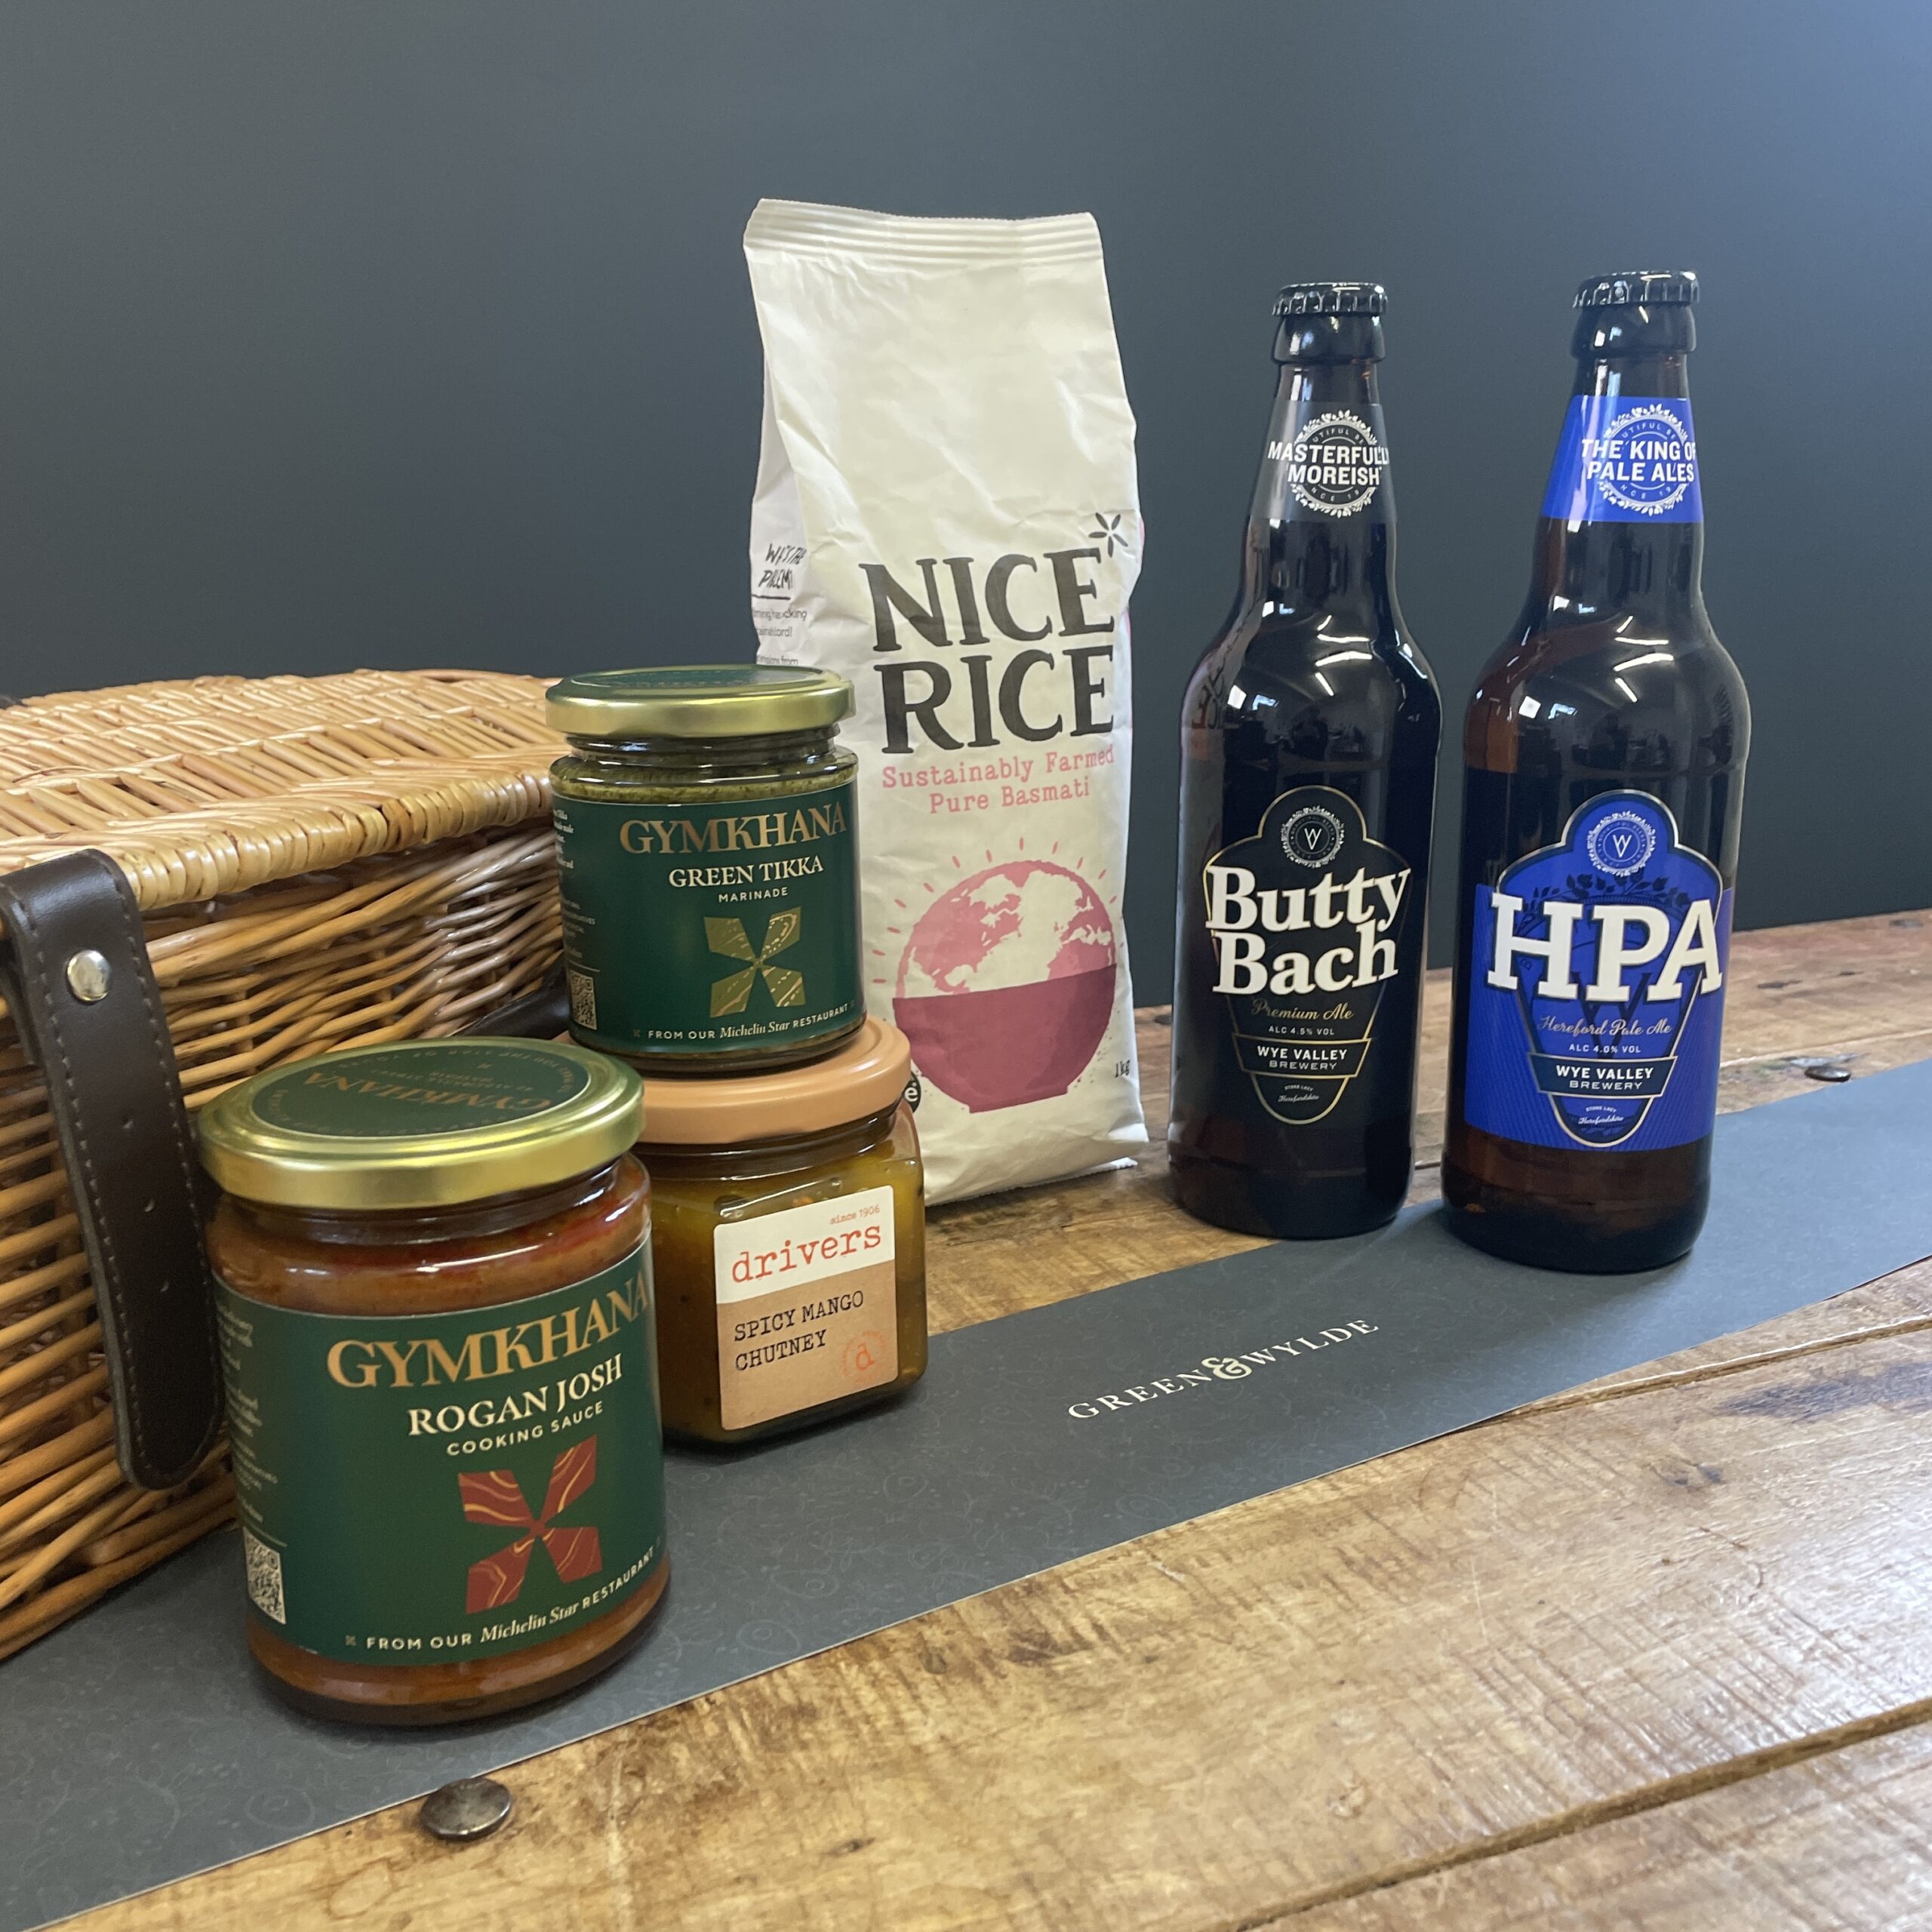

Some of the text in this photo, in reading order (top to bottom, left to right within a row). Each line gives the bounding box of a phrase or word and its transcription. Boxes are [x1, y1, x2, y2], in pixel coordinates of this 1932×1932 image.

[1581, 439, 1624, 459] THE
[1629, 441, 1681, 460] KING
[1287, 464, 1380, 485] MOREISH
[1586, 461, 1694, 482] PALE ALES
[858, 548, 1115, 651] NICE
[873, 645, 1114, 753] RICE
[882, 744, 1115, 788] Sustainably Farmed
[929, 778, 1089, 814] Pure Basmati
[619, 801, 847, 854] GYMKHANA
[669, 855, 824, 888] GREEN TIKKA
[718, 887, 789, 903] MARINADE
[1205, 865, 1411, 933] Butty
[1212, 918, 1398, 996] Bach
[1487, 891, 1722, 1002] HPA
[648, 1003, 848, 1040] FROM OUR Michelin Star RESTAURANT
[1251, 998, 1353, 1020] Premium Ale
[1537, 1015, 1672, 1037] Hereford Pale Ale
[1269, 1026, 1287, 1034] ALC
[1317, 1027, 1334, 1035] VOL
[1569, 1044, 1589, 1052] ALC
[1593, 1044, 1618, 1054] 4.0%
[1257, 1045, 1347, 1060] WYE VALLEY
[1269, 1060, 1337, 1070] BREWERY
[1556, 1065, 1654, 1079] WYE VALLEY
[1569, 1080, 1642, 1090] BREWERY
[303, 1071, 552, 1112] GYMKHANA
[830, 1206, 881, 1224] since 1906
[732, 1224, 881, 1283] drivers
[327, 1270, 649, 1389] GYMKHANA
[734, 1291, 864, 1342] SPICY MANGO
[735, 1329, 827, 1371] CHUTNEY
[408, 1353, 623, 1437] ROGAN JOSH
[446, 1401, 604, 1457] COOKING SAUCE
[367, 1546, 654, 1651] FROM OUR Michelin Star RESTAURANT
